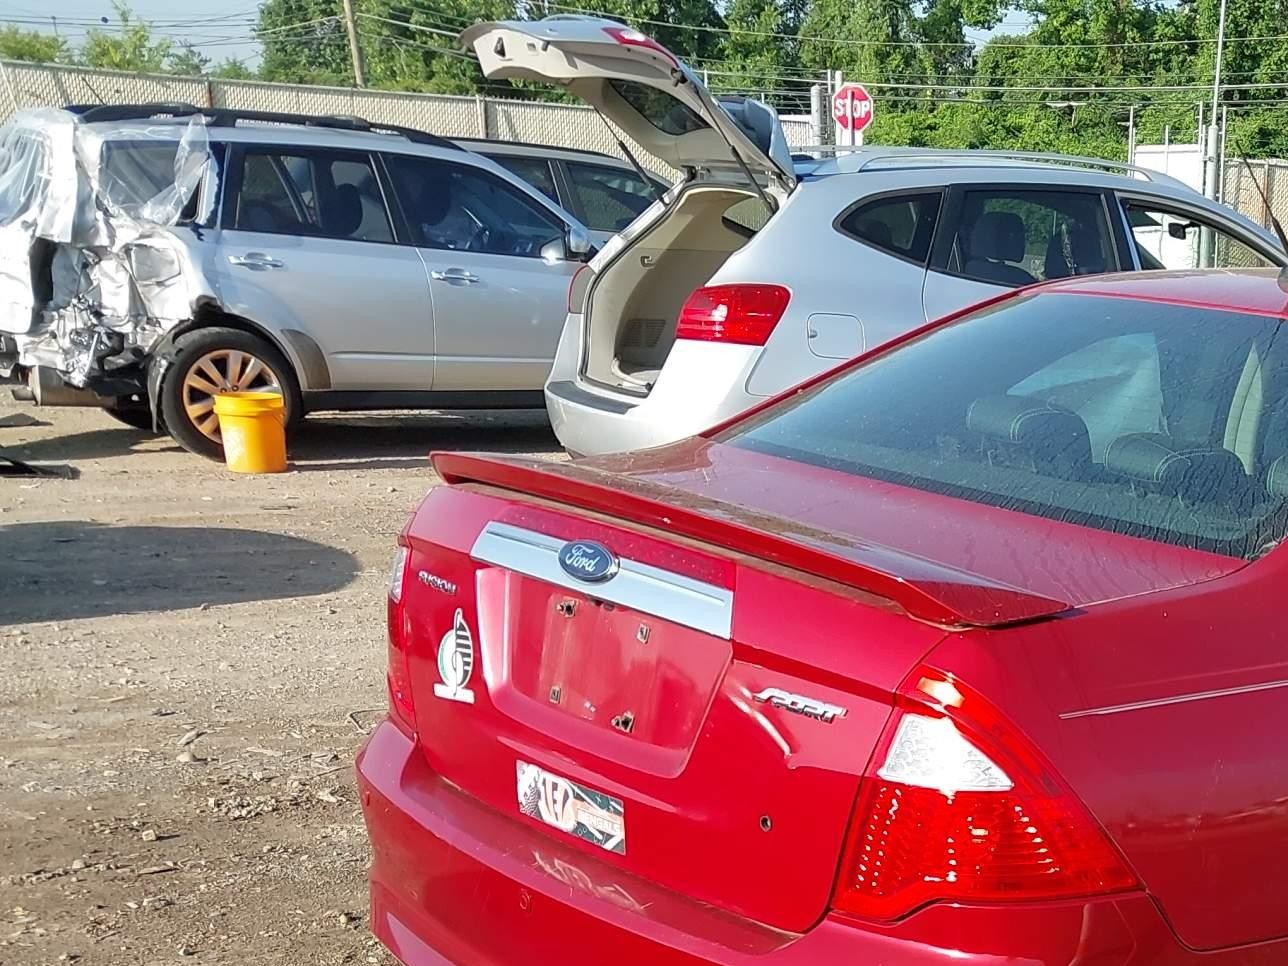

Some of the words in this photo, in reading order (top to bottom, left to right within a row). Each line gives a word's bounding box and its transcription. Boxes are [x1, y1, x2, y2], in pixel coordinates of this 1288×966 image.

[834, 98, 871, 118] STOP
[565, 544, 601, 573] Ford
[752, 687, 848, 725] SPORT
